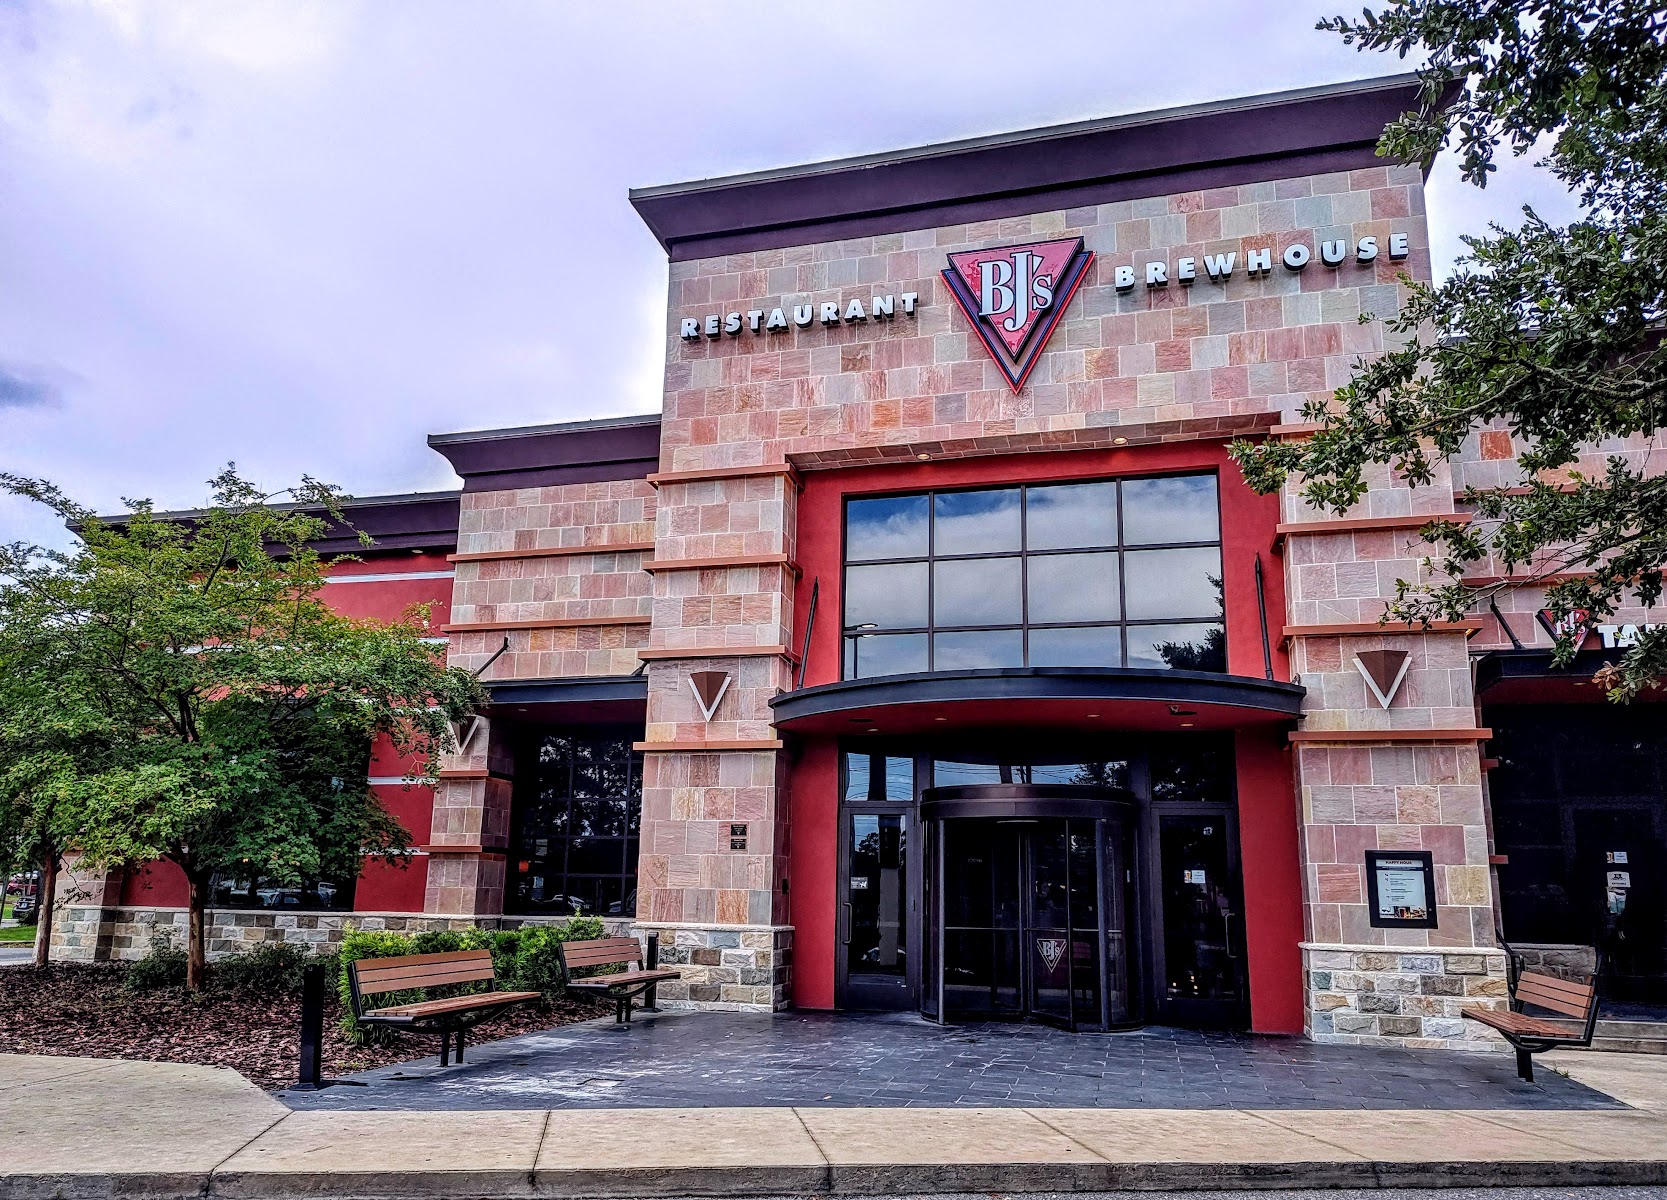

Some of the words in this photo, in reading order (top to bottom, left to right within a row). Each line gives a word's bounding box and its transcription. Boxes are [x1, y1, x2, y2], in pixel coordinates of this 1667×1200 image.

[1115, 233, 1408, 290] BREWHOUSE
[681, 292, 918, 339] RESTAURANT
[979, 251, 1054, 331] BJ's
[1598, 623, 1667, 648] TA
